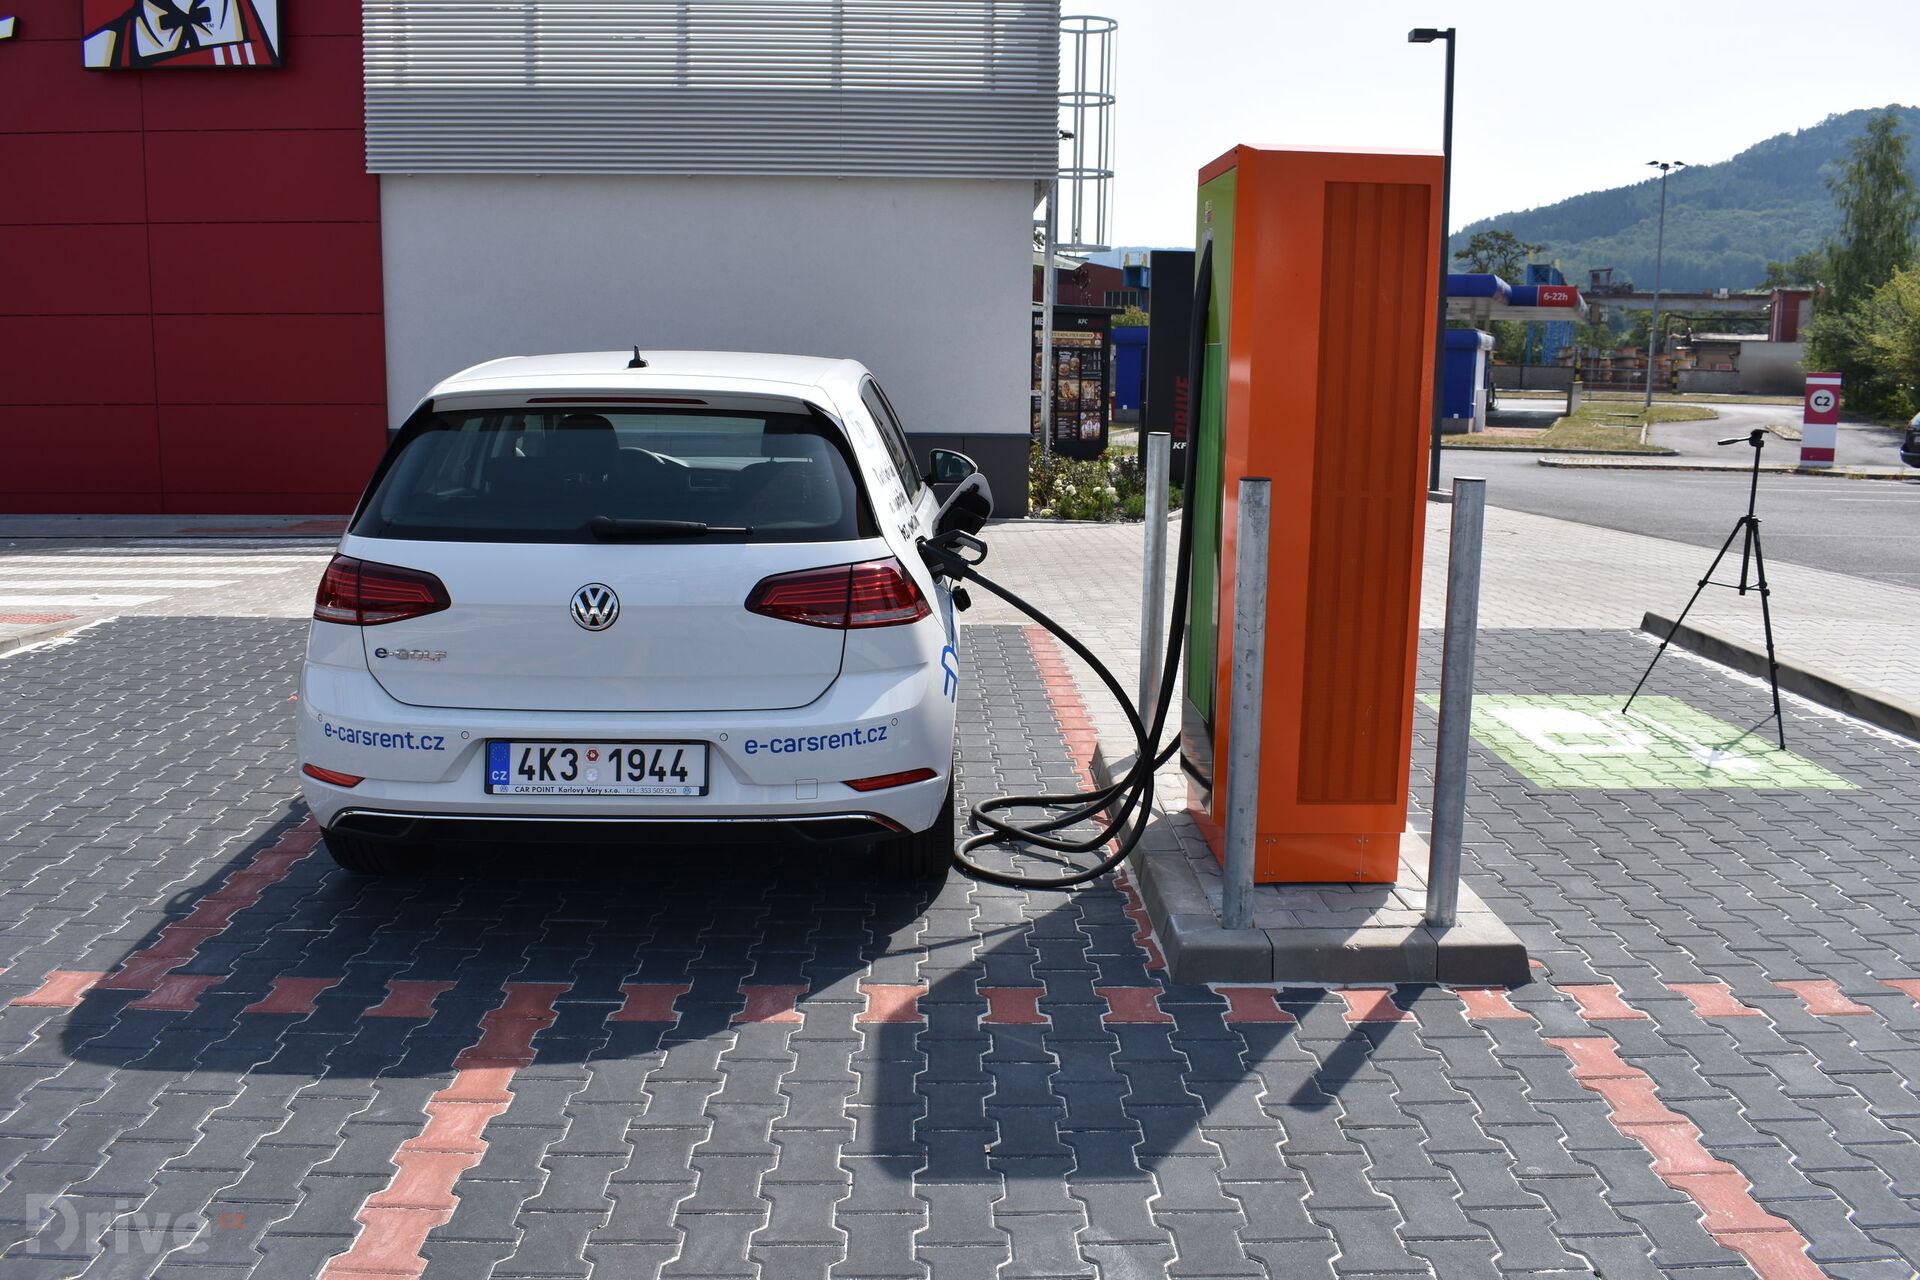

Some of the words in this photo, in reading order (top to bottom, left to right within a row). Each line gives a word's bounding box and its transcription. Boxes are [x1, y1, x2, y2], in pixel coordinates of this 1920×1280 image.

[1543, 292, 1568, 301] 6-22h
[1174, 375, 1188, 439] DRIVE
[1814, 395, 1831, 407] C2
[1172, 441, 1187, 450] KF
[324, 722, 446, 751] e-carsrent.cz
[744, 725, 888, 755] e-carsrent.cz
[517, 747, 579, 782] 4K3
[608, 748, 689, 783] 1944
[491, 770, 508, 781] CZ
[558, 786, 584, 795] Karlovy
[586, 786, 602, 795] Vary
